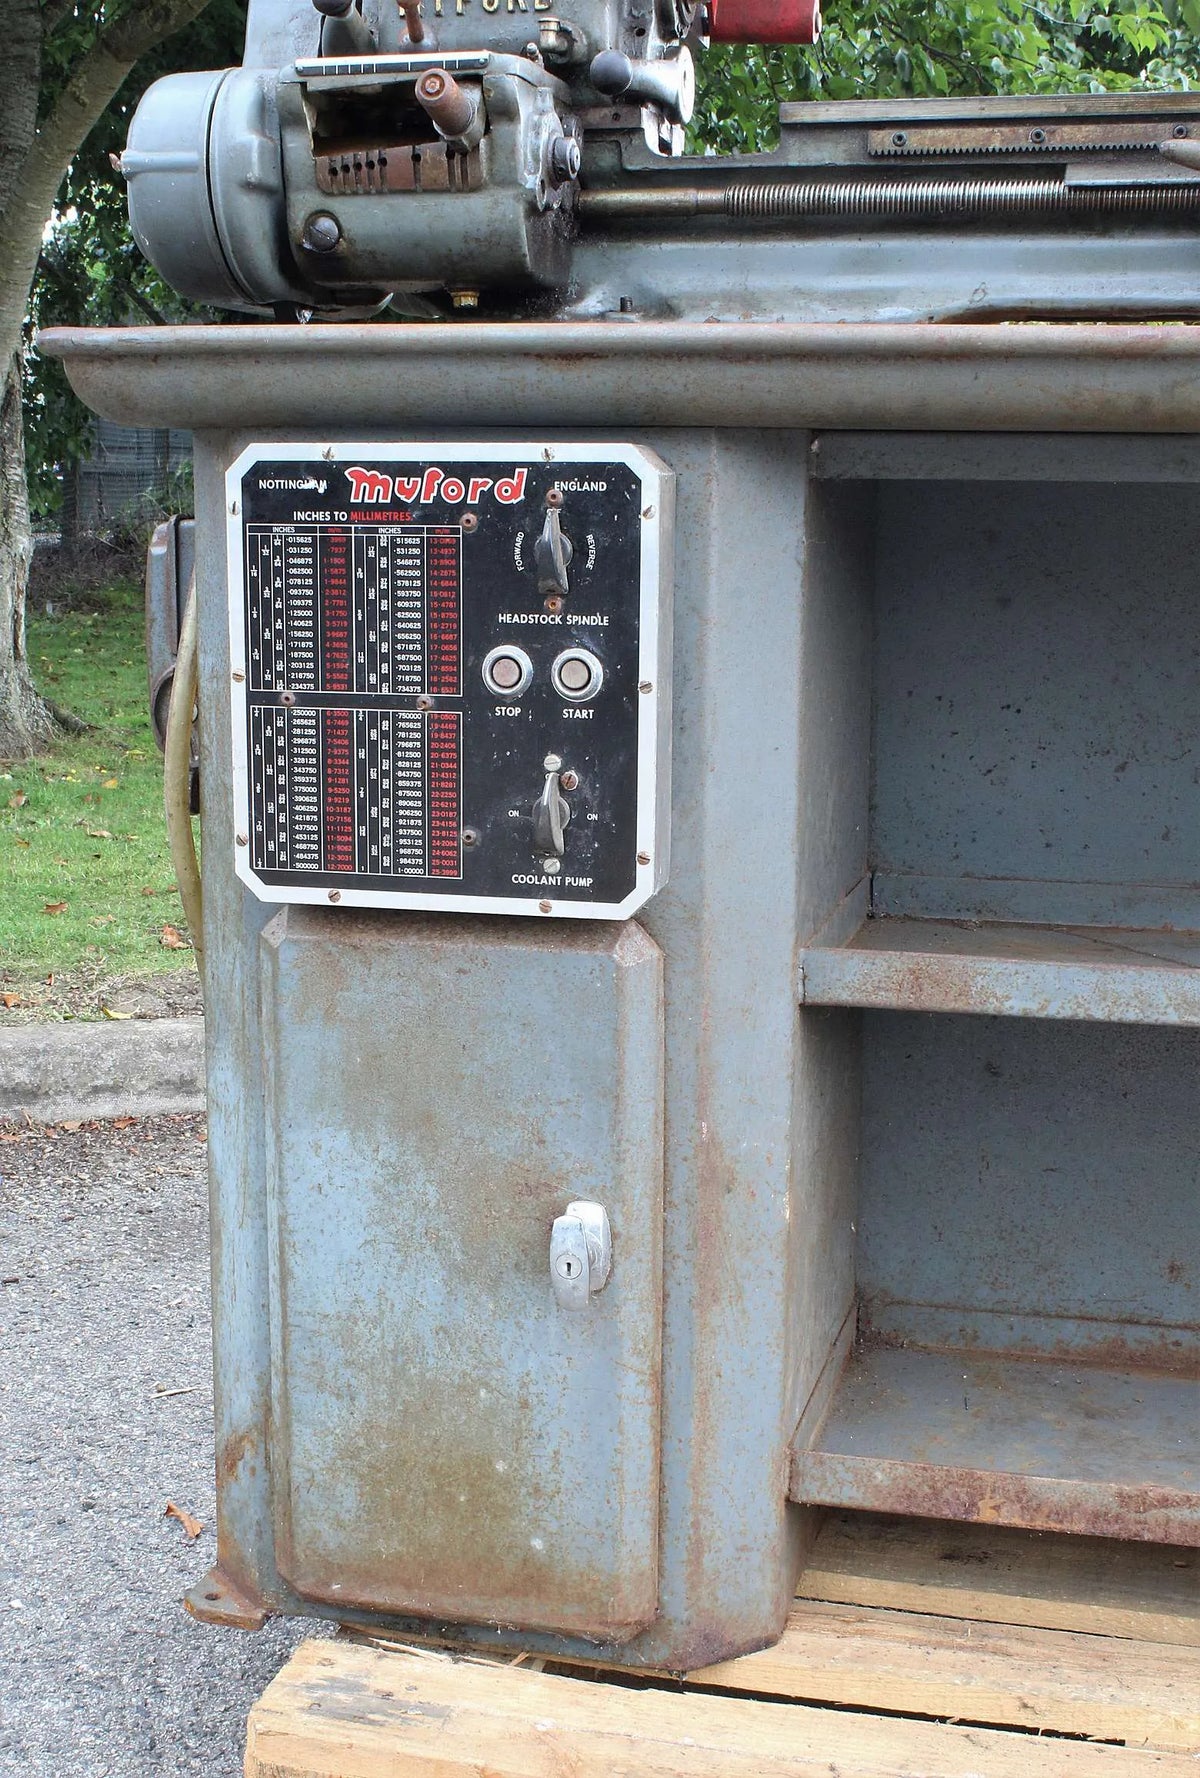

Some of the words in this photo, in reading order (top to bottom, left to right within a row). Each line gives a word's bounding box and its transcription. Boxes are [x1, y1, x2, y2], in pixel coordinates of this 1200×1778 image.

[554, 480, 607, 492] ENGLAND
[293, 511, 330, 521] INCHES
[333, 511, 347, 521] TO
[515, 531, 524, 571] FORWARD
[586, 534, 597, 570] REVERSE
[498, 613, 562, 625] HEADSTOCK
[566, 614, 609, 626] SPINDLE
[495, 707, 522, 717] STOP
[563, 709, 594, 719] START
[512, 874, 562, 886] COOLANT
[565, 877, 593, 887] PUMP
